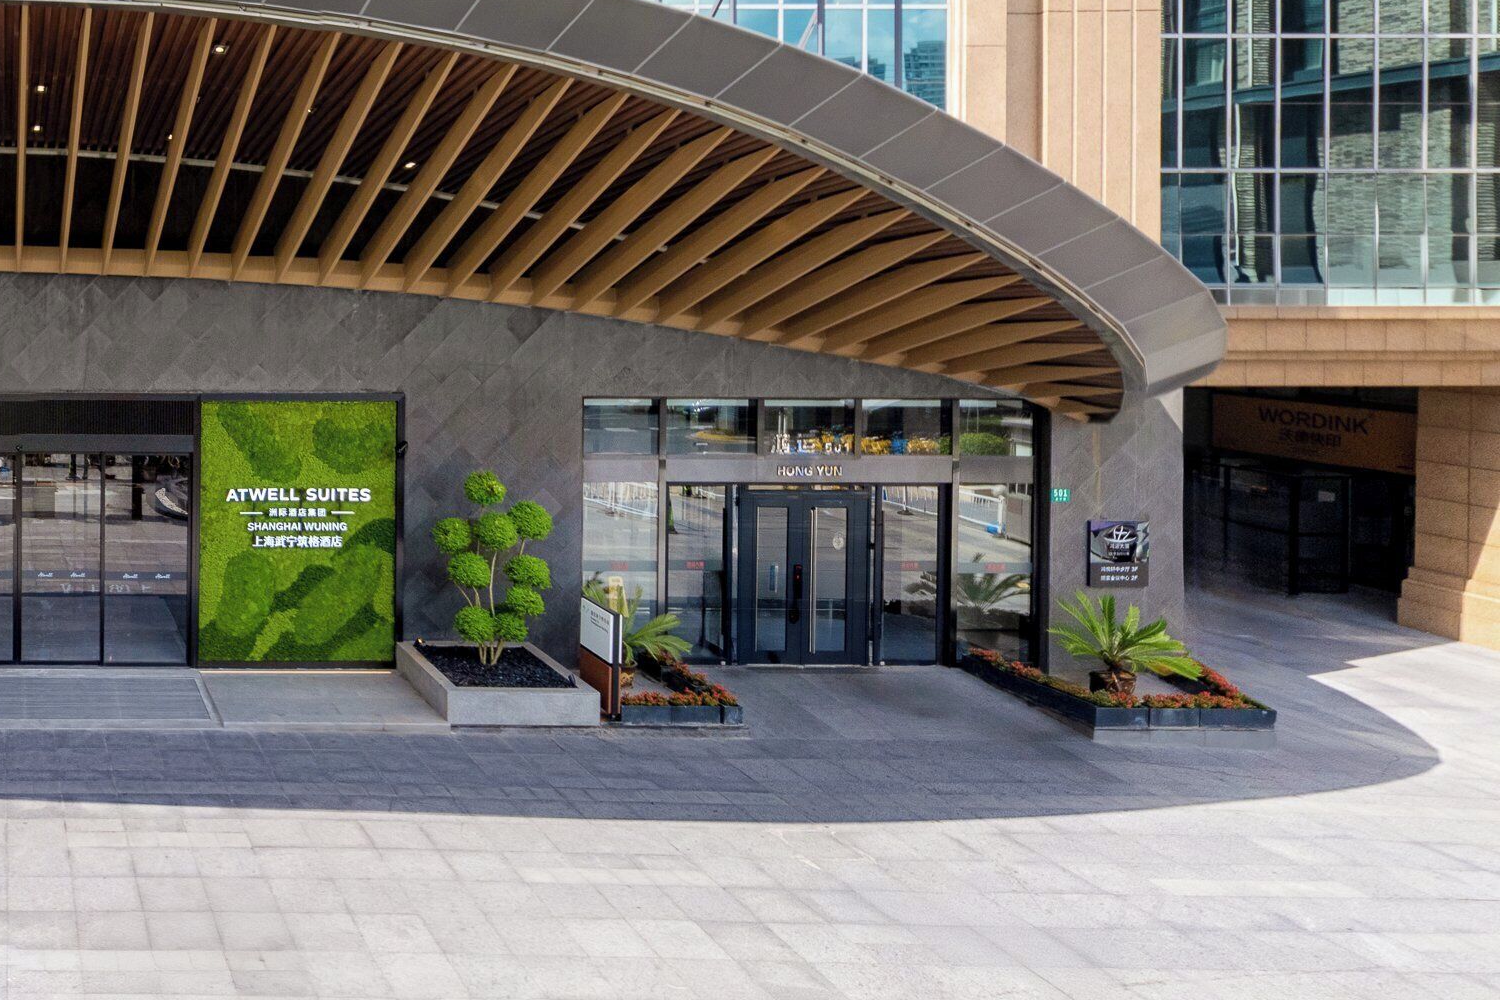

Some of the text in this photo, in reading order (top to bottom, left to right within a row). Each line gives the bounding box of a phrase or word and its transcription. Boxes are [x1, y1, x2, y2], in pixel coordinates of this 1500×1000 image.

[1258, 406, 1368, 435] WORDINK
[777, 465, 843, 477] HONG YUN
[226, 488, 371, 502] ATWELL SUITES
[1053, 488, 1068, 497] 501
[268, 507, 327, 517] 洲际酒店集团
[247, 522, 348, 531] SHANGHAI WUNING
